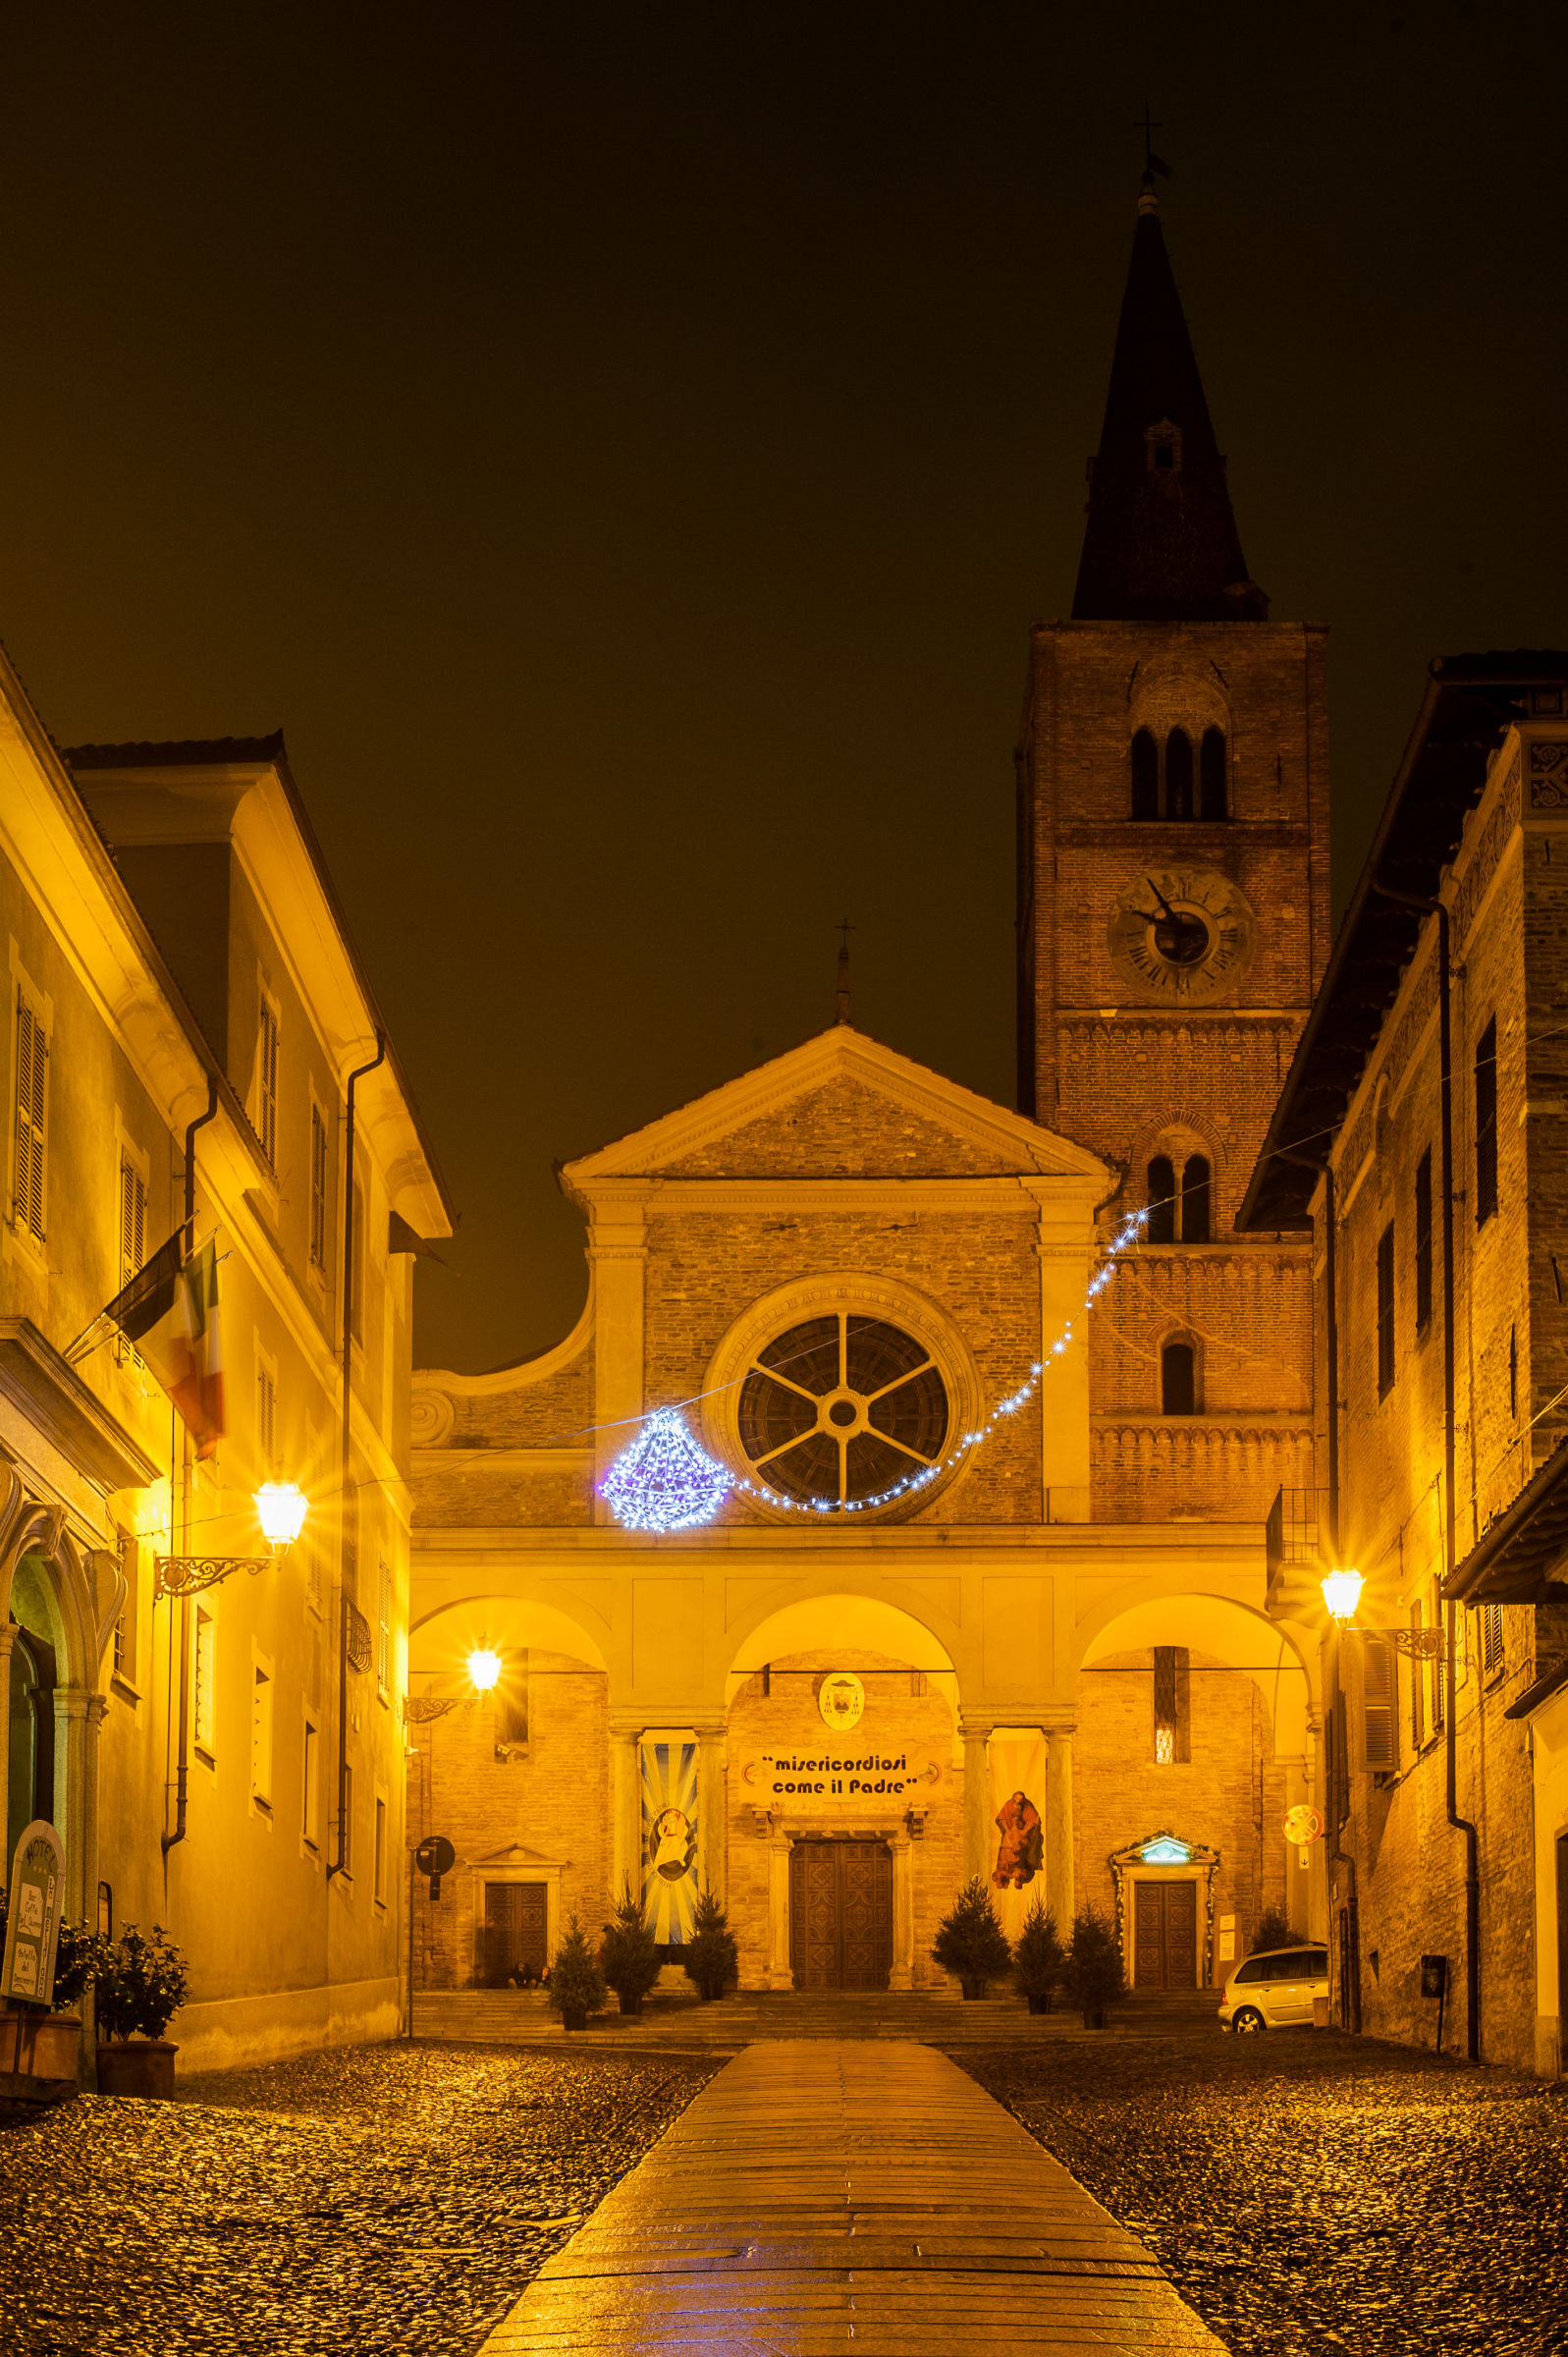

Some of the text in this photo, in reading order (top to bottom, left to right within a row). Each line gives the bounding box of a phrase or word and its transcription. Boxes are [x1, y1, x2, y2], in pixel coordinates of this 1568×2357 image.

[772, 1781, 825, 1794] come
[831, 1779, 842, 1794] il
[27, 1838, 56, 1872] HOTEL
